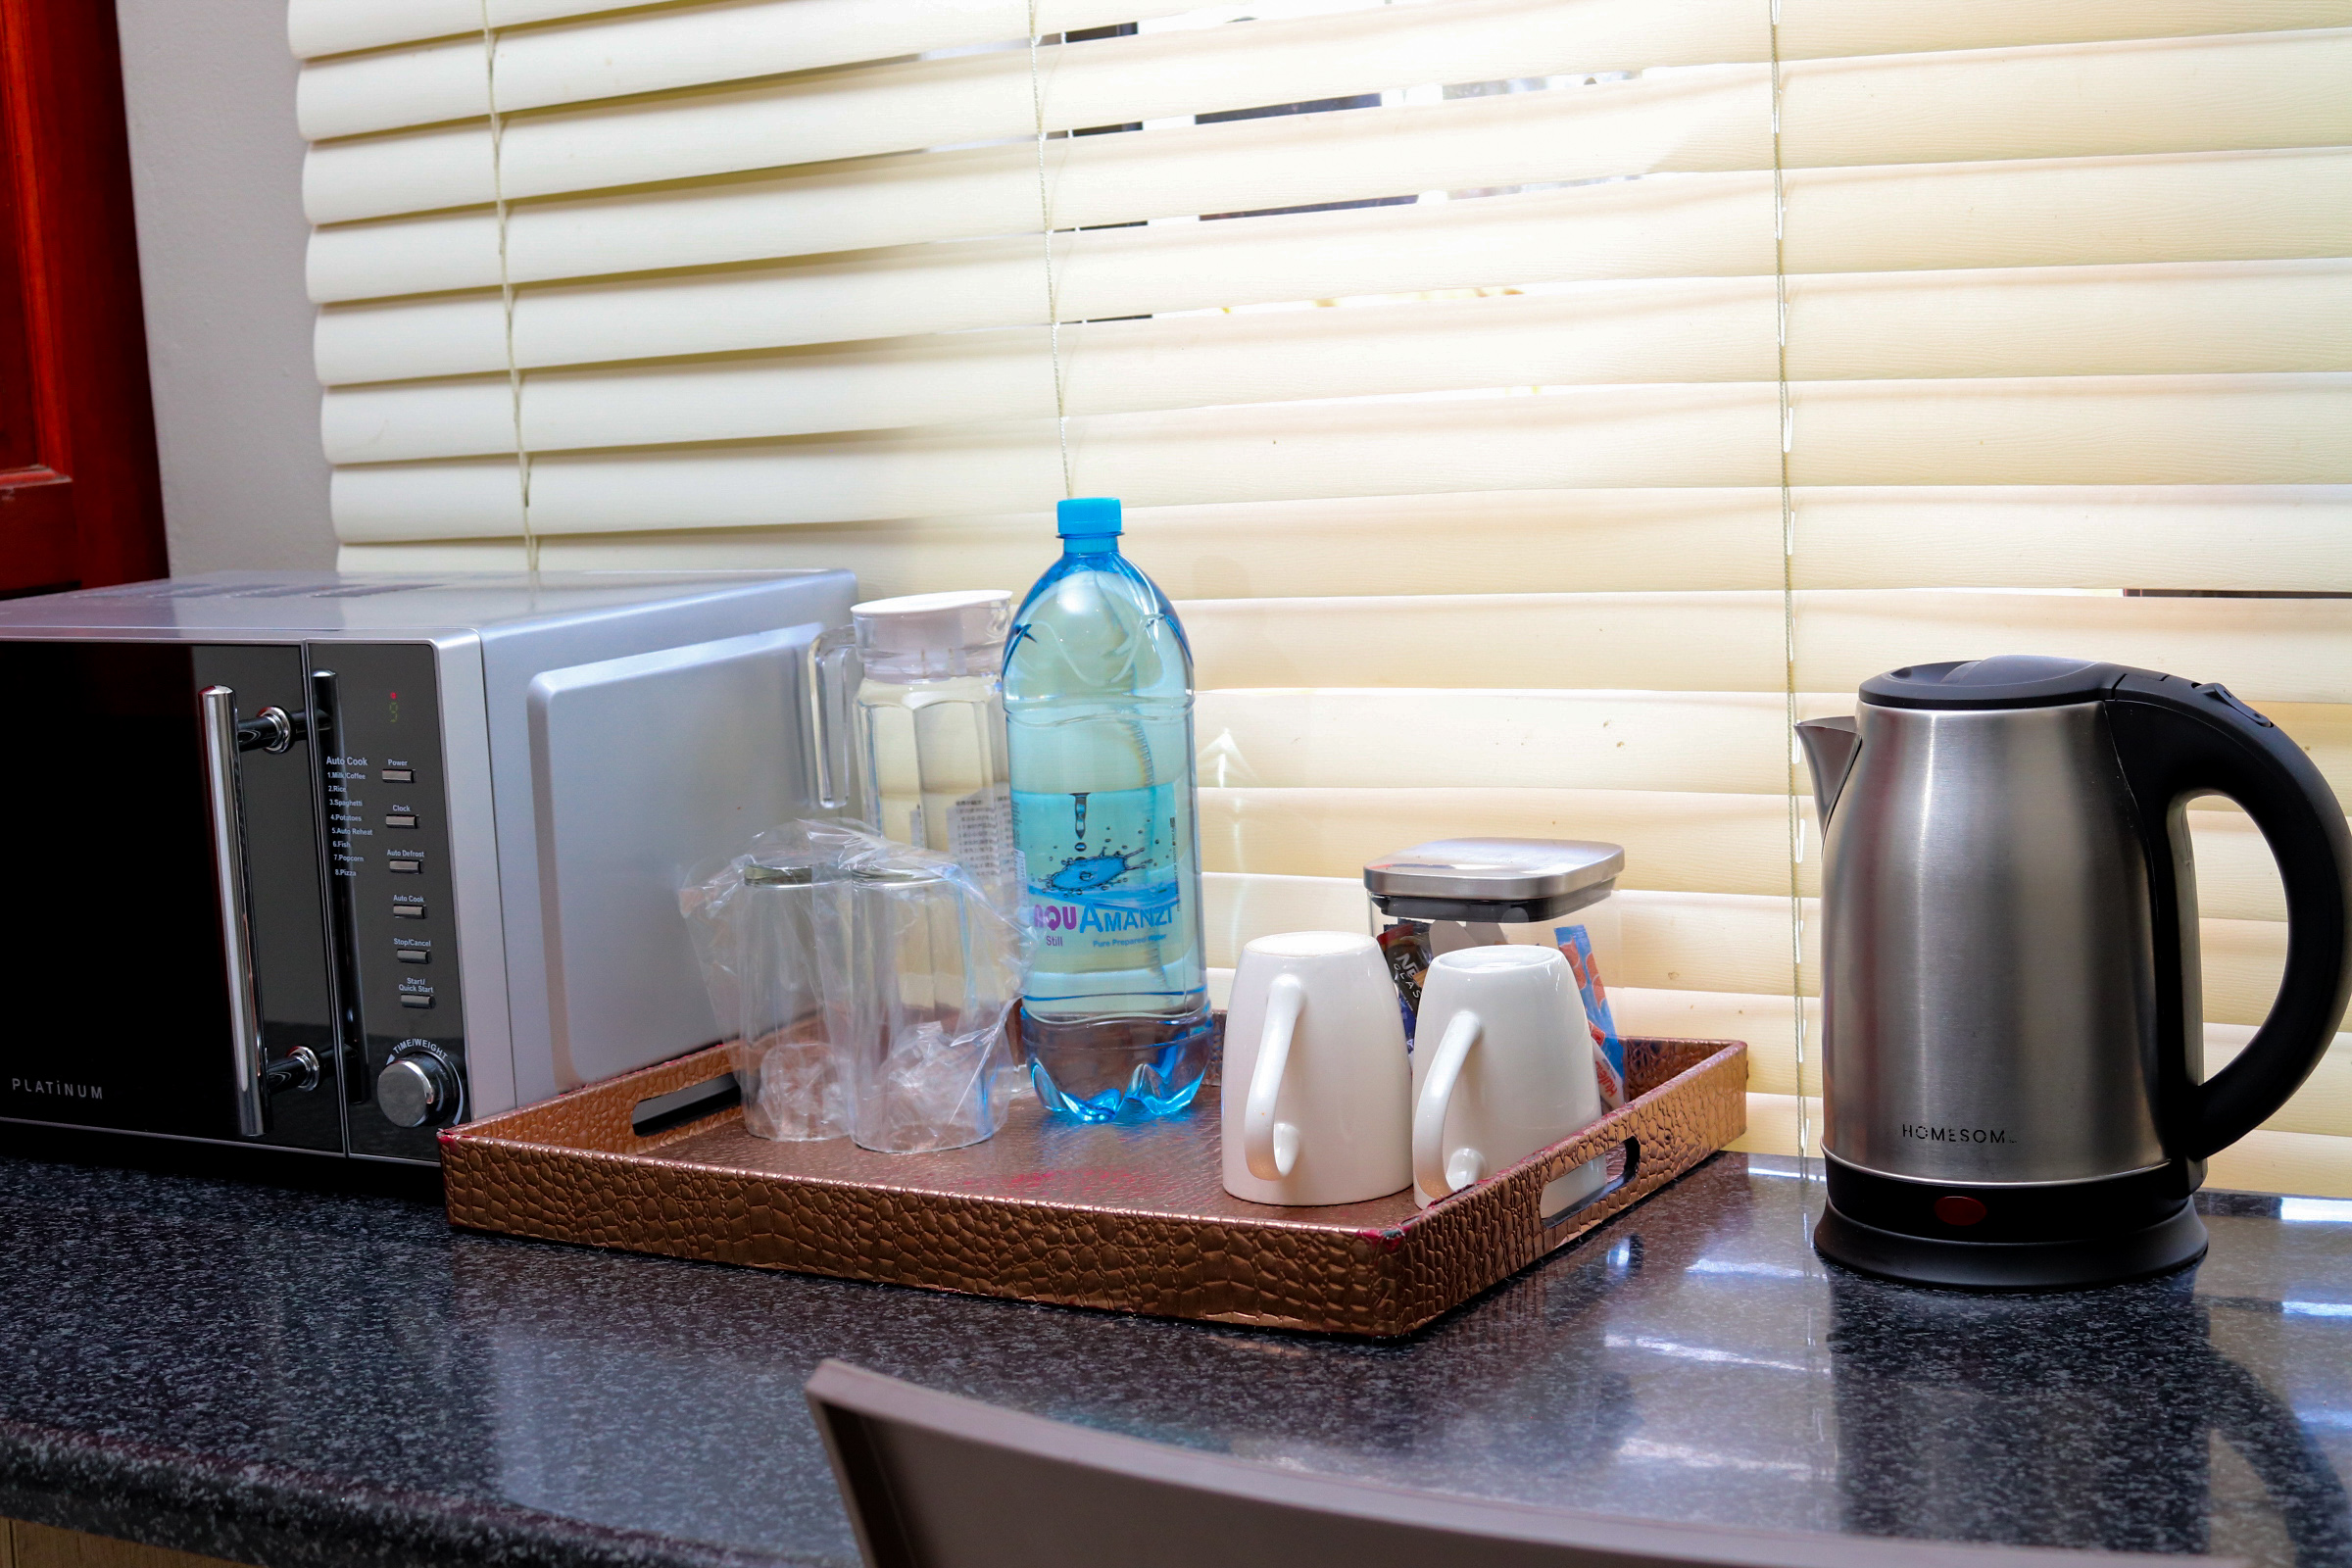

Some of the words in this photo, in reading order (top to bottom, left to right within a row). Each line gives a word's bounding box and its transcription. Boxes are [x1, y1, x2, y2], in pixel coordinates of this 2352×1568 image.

[326, 756, 345, 765] Auto
[346, 757, 368, 766] Cook
[328, 799, 364, 808] 3.Spaghetti
[392, 804, 411, 812] Clock
[330, 813, 363, 822] 4.Potatoes
[333, 854, 365, 862] 7.Popcorn
[334, 868, 357, 877] 8.Pizza
[393, 937, 431, 947] Stop/Cancel
[1046, 935, 1063, 947] Still
[417, 985, 434, 994] Start
[393, 1038, 449, 1059] TIME/WEIGHT
[1902, 1123, 2017, 1144] HOMESOM
